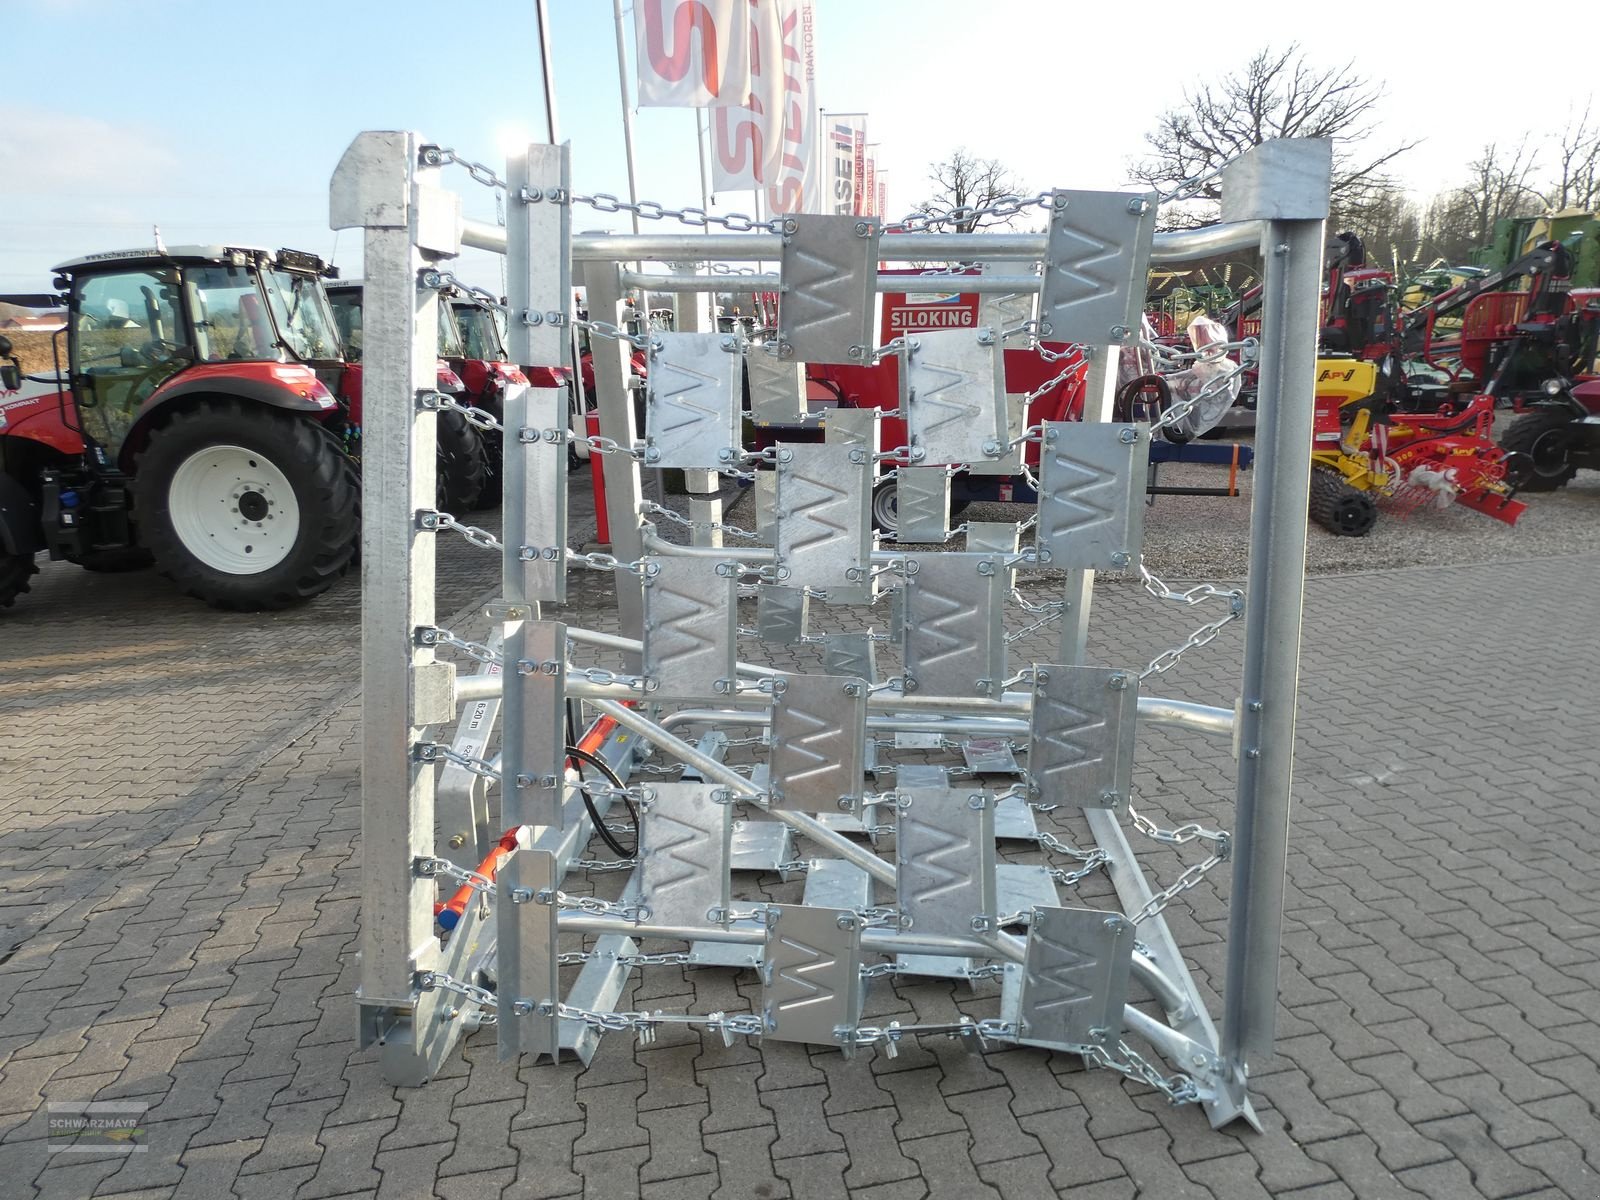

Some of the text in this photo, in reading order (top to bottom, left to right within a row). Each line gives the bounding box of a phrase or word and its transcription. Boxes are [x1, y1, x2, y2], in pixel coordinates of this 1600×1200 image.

[803, 5, 815, 82] TRAKTOREN
[855, 133, 864, 196] AGRICULTURE
[891, 311, 972, 326] SILOKING
[4, 399, 40, 411] KOMPAKT
[473, 703, 487, 721] 6.20
